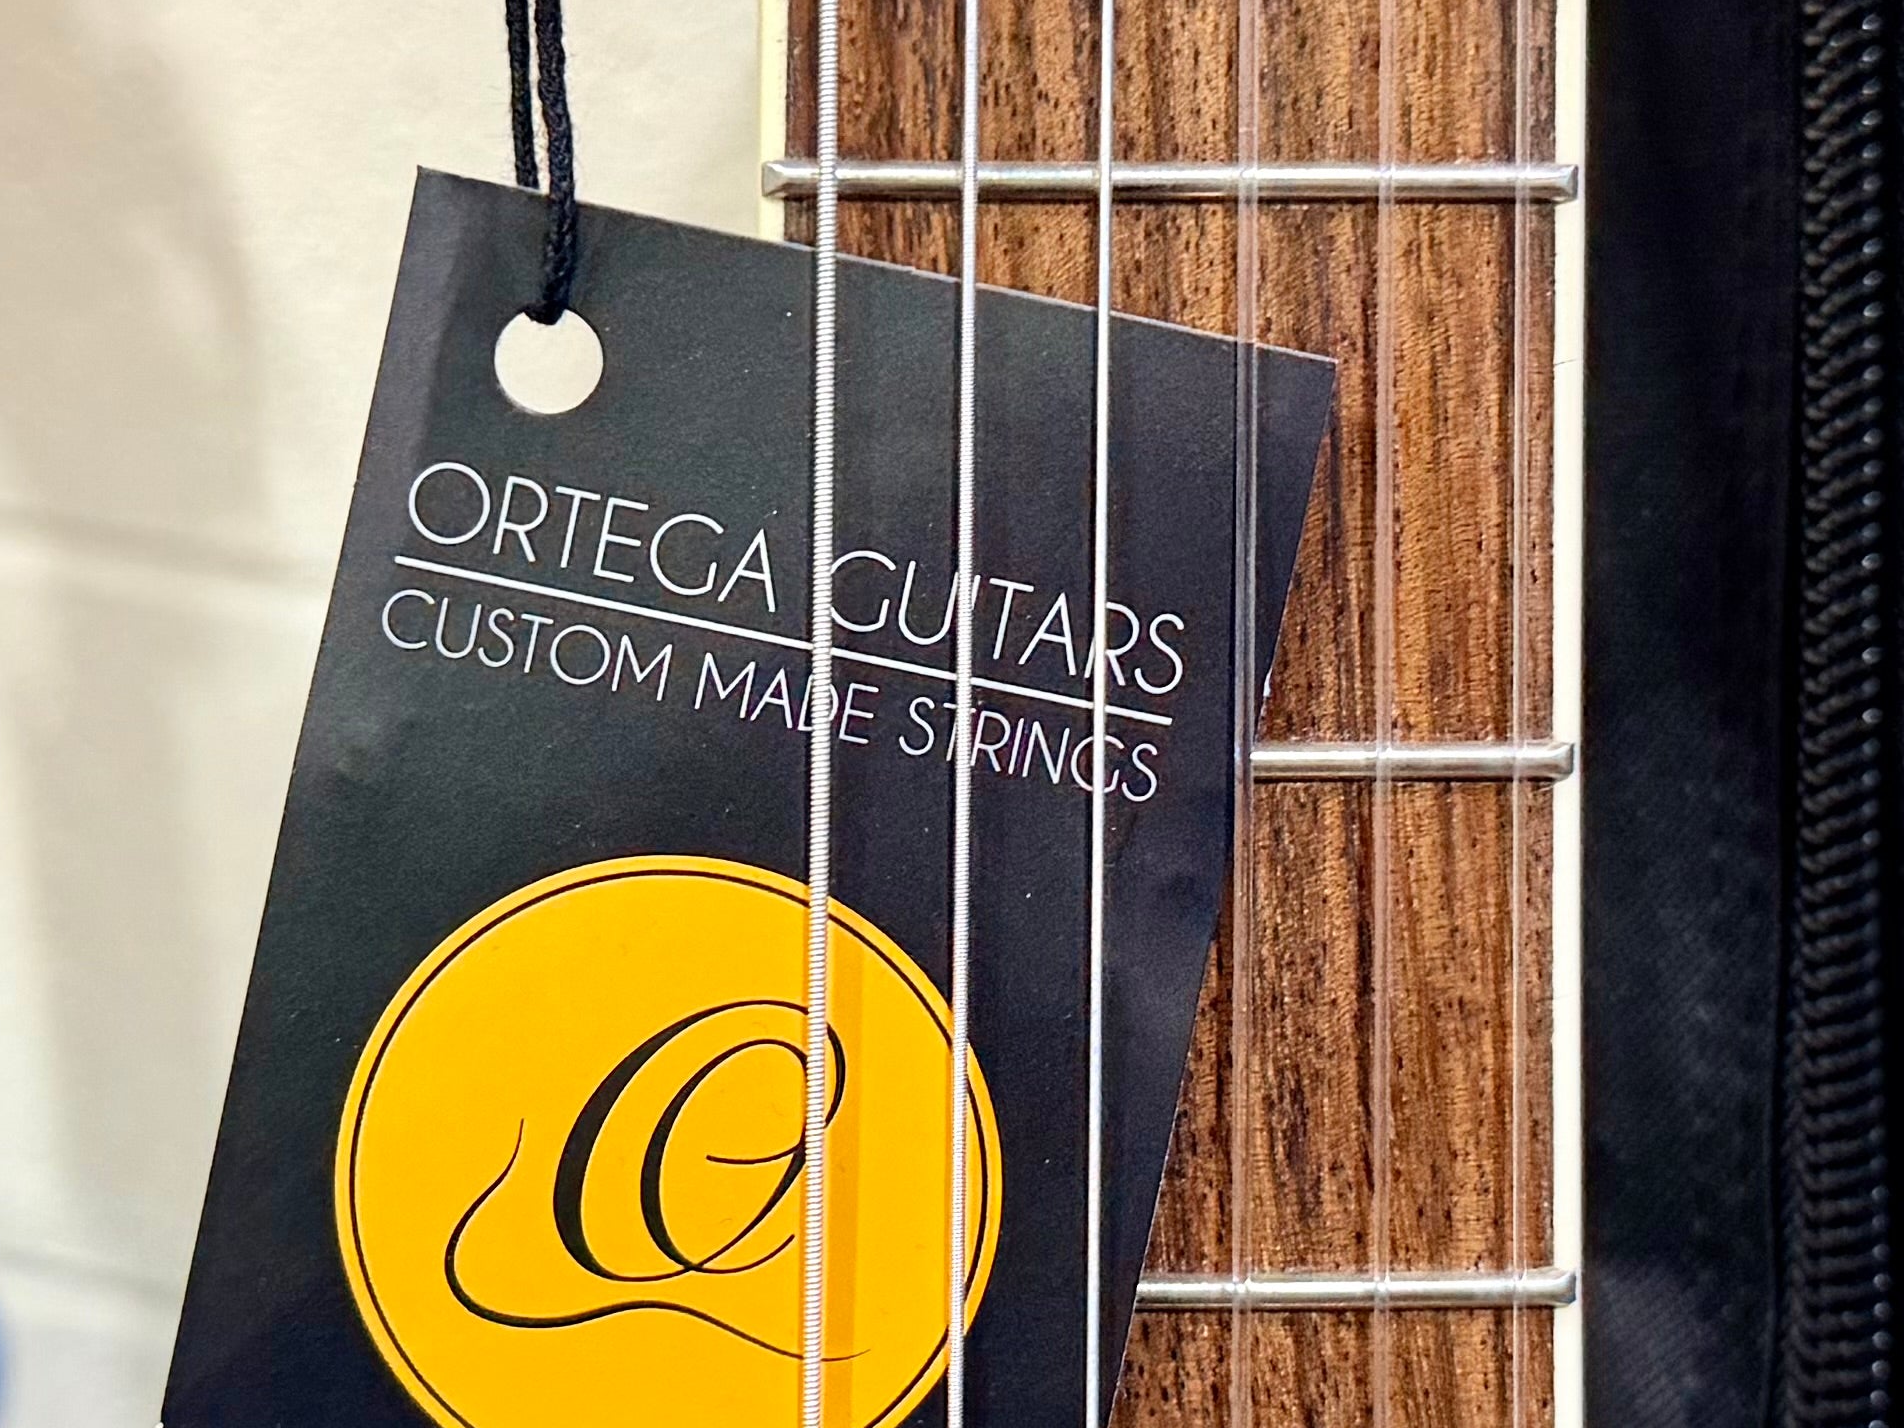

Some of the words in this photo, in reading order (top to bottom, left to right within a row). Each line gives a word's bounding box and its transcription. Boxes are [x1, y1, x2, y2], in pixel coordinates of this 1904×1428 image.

[407, 460, 778, 613] ORTEGA
[381, 588, 674, 702] CUSTOM
[693, 651, 881, 745] MADE
[897, 695, 1160, 803] STRINGS
